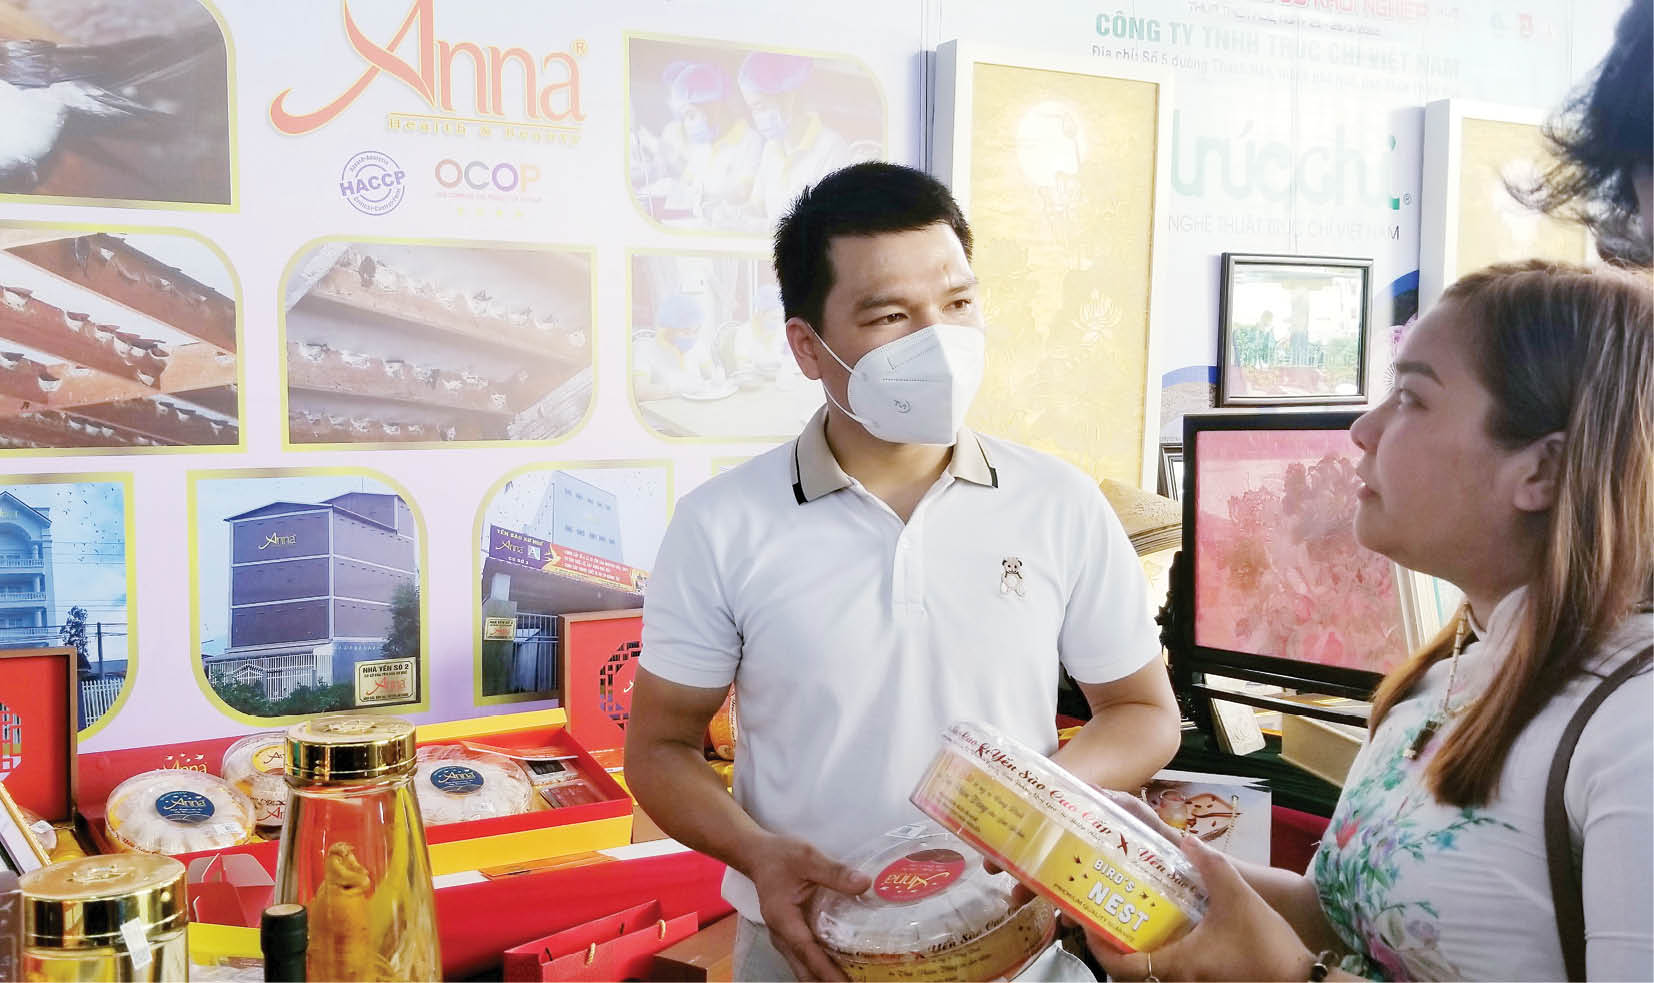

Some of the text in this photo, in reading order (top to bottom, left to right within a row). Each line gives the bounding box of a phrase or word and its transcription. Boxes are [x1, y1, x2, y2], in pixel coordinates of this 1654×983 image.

[1096, 10, 1161, 42] CÔNG
[1169, 21, 1194, 45] TY
[269, 0, 586, 135] Anna
[340, 170, 405, 197] HACCP
[434, 158, 542, 193] OCOP
[258, 532, 297, 550] Anna
[990, 747, 1017, 772] Yến
[163, 797, 207, 810] Anna
[1093, 858, 1136, 893] BIRD'S
[1087, 880, 1150, 932] NEST
